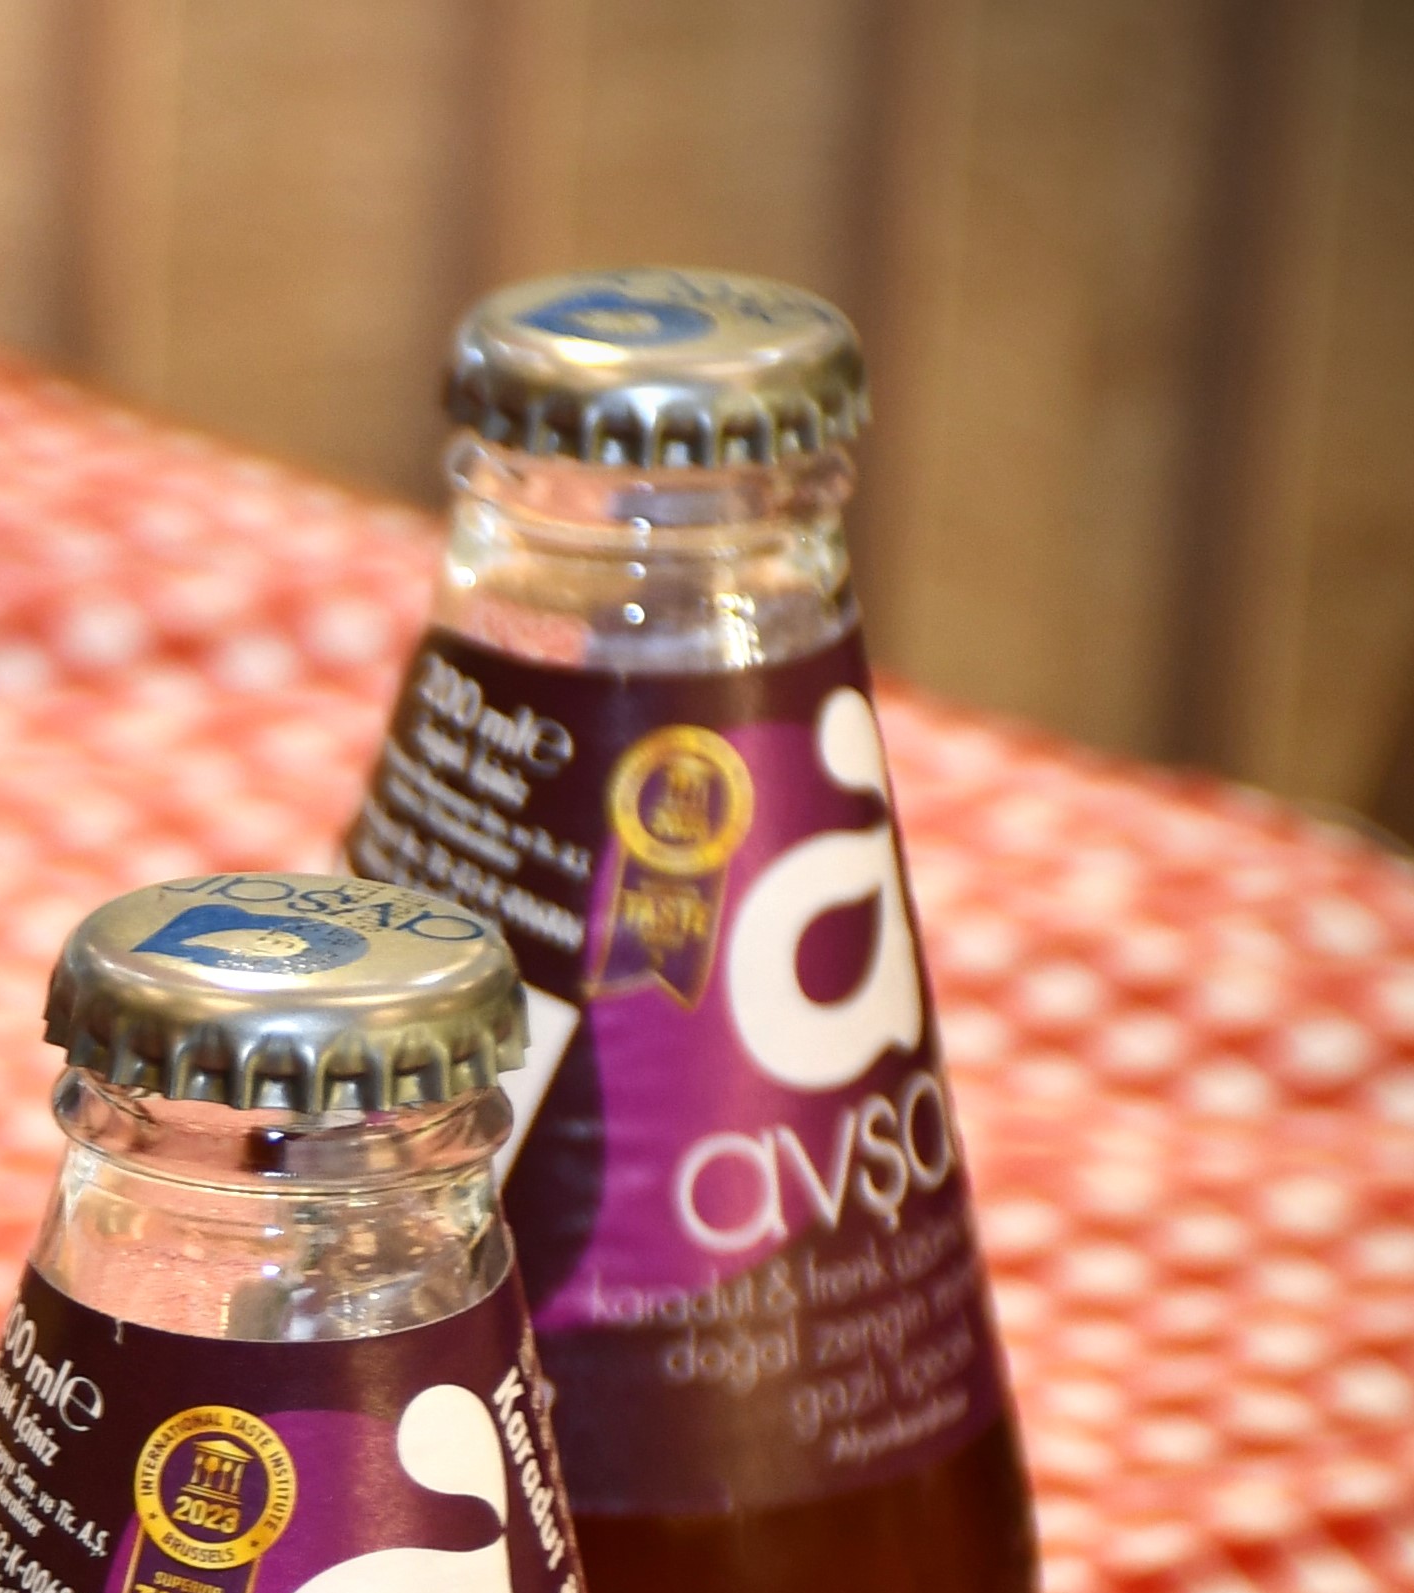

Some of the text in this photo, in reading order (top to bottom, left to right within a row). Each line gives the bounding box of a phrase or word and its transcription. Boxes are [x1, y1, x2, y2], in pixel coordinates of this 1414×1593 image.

[677, 1071, 956, 1250] avşa
[140, 1414, 295, 1531] INTERNATIONAL TASTE INSTITUTE
[173, 1496, 241, 1534] 2023
[493, 1365, 565, 1572] Karadut
[161, 1531, 236, 1564] BRUSSELS
